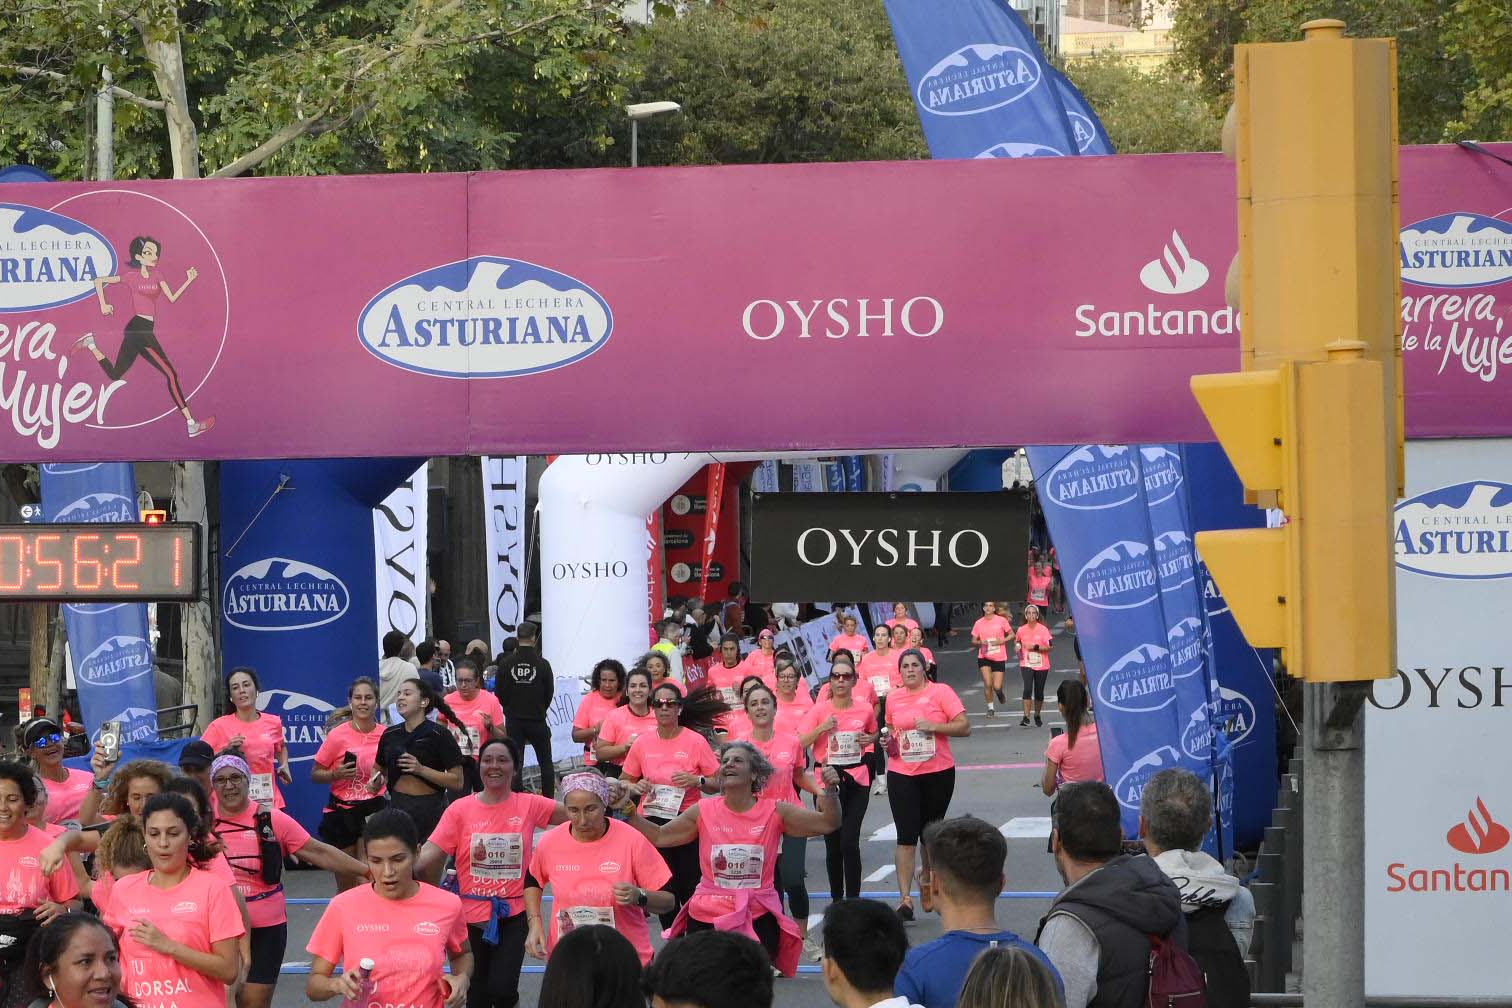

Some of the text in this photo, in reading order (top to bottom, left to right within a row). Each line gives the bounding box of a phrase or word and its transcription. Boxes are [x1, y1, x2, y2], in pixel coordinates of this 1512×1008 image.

[20, 240, 92, 251] LECHERA
[1415, 238, 1466, 247] CENTRAL
[417, 297, 585, 312] CENTRAL LECHERA
[1400, 293, 1496, 322] arrera
[377, 303, 593, 348] ASTURIANA
[742, 296, 944, 341] OYSHO
[1075, 304, 1240, 337] Santand
[1424, 334, 1442, 352] la
[1422, 516, 1489, 526] CENTRAL
[1395, 519, 1512, 557] ASTURI
[797, 527, 990, 569] OYSHO
[552, 560, 627, 580] OYSHO
[240, 582, 336, 591] CENTRAL LECHERA
[227, 588, 340, 615] ASTURIANA
[517, 668, 530, 677] BP
[487, 851, 505, 859] 016
[728, 861, 745, 869] 016
